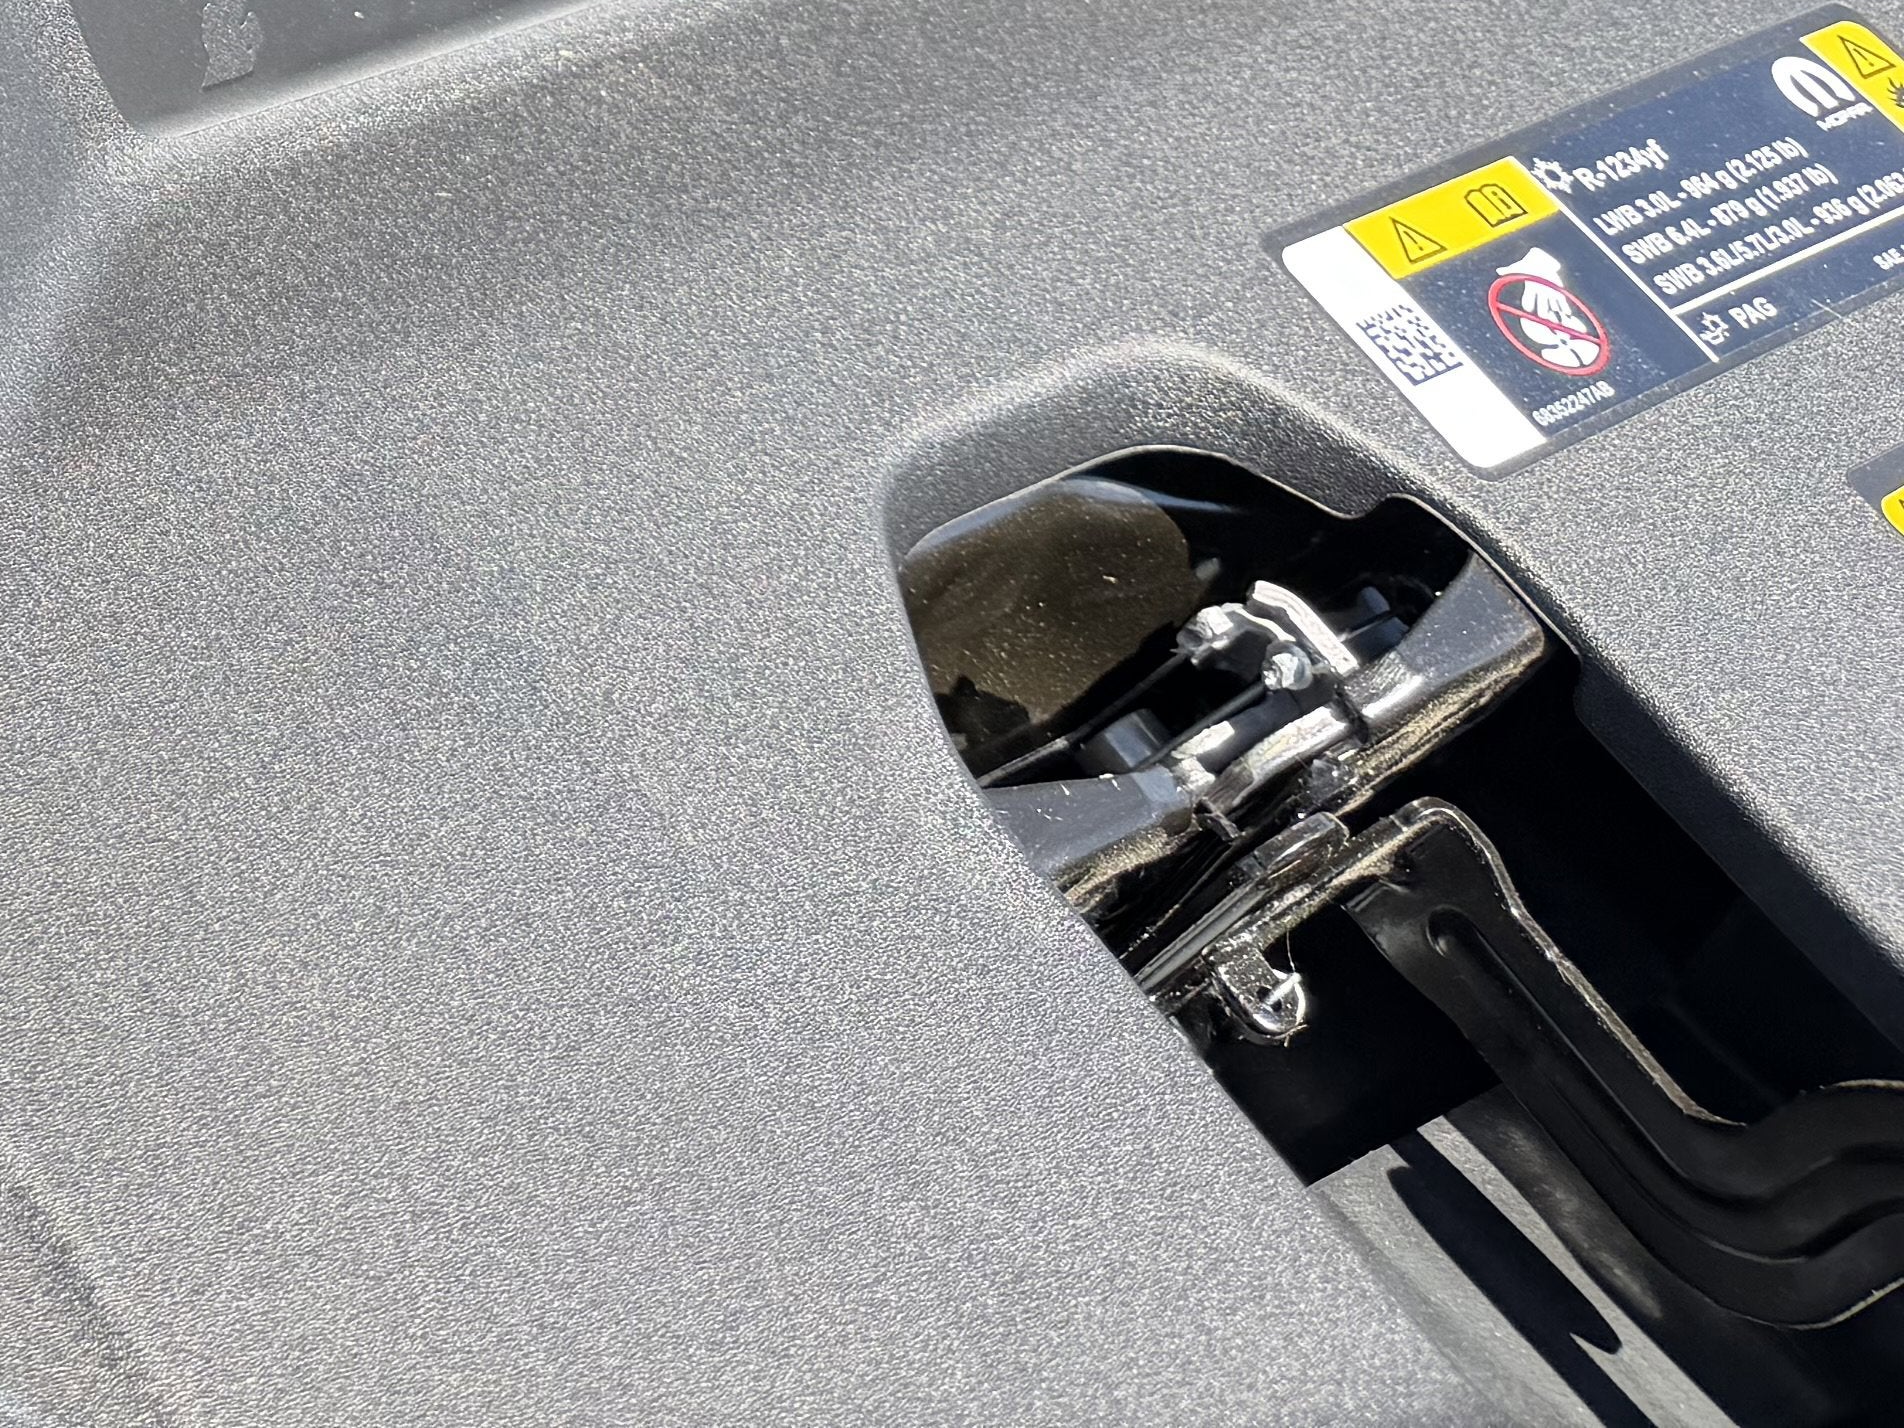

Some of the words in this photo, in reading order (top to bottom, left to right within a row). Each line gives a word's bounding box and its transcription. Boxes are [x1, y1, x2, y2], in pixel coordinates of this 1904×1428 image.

[1572, 138, 1670, 192] R-1234yf
[1725, 144, 1783, 184] (2.125
[1771, 136, 1810, 160] lb)
[1714, 169, 1740, 190] g
[1801, 162, 1839, 185] lb)
[1638, 190, 1682, 221] 3.0L
[1743, 196, 1770, 217] g
[1754, 172, 1811, 211] (1.937
[1592, 202, 1644, 236] LWB
[1709, 199, 1750, 227] 879
[1621, 228, 1674, 264] SWB
[1652, 261, 1706, 296] SWB
[1695, 216, 1815, 277] 3.6L/5.7L/3.0L
[1812, 197, 1853, 225] 936
[1846, 194, 1872, 216] g
[1669, 216, 1713, 247] 6.4L
[1727, 296, 1778, 331] PAG
[1531, 379, 1616, 428] 68352247AB
